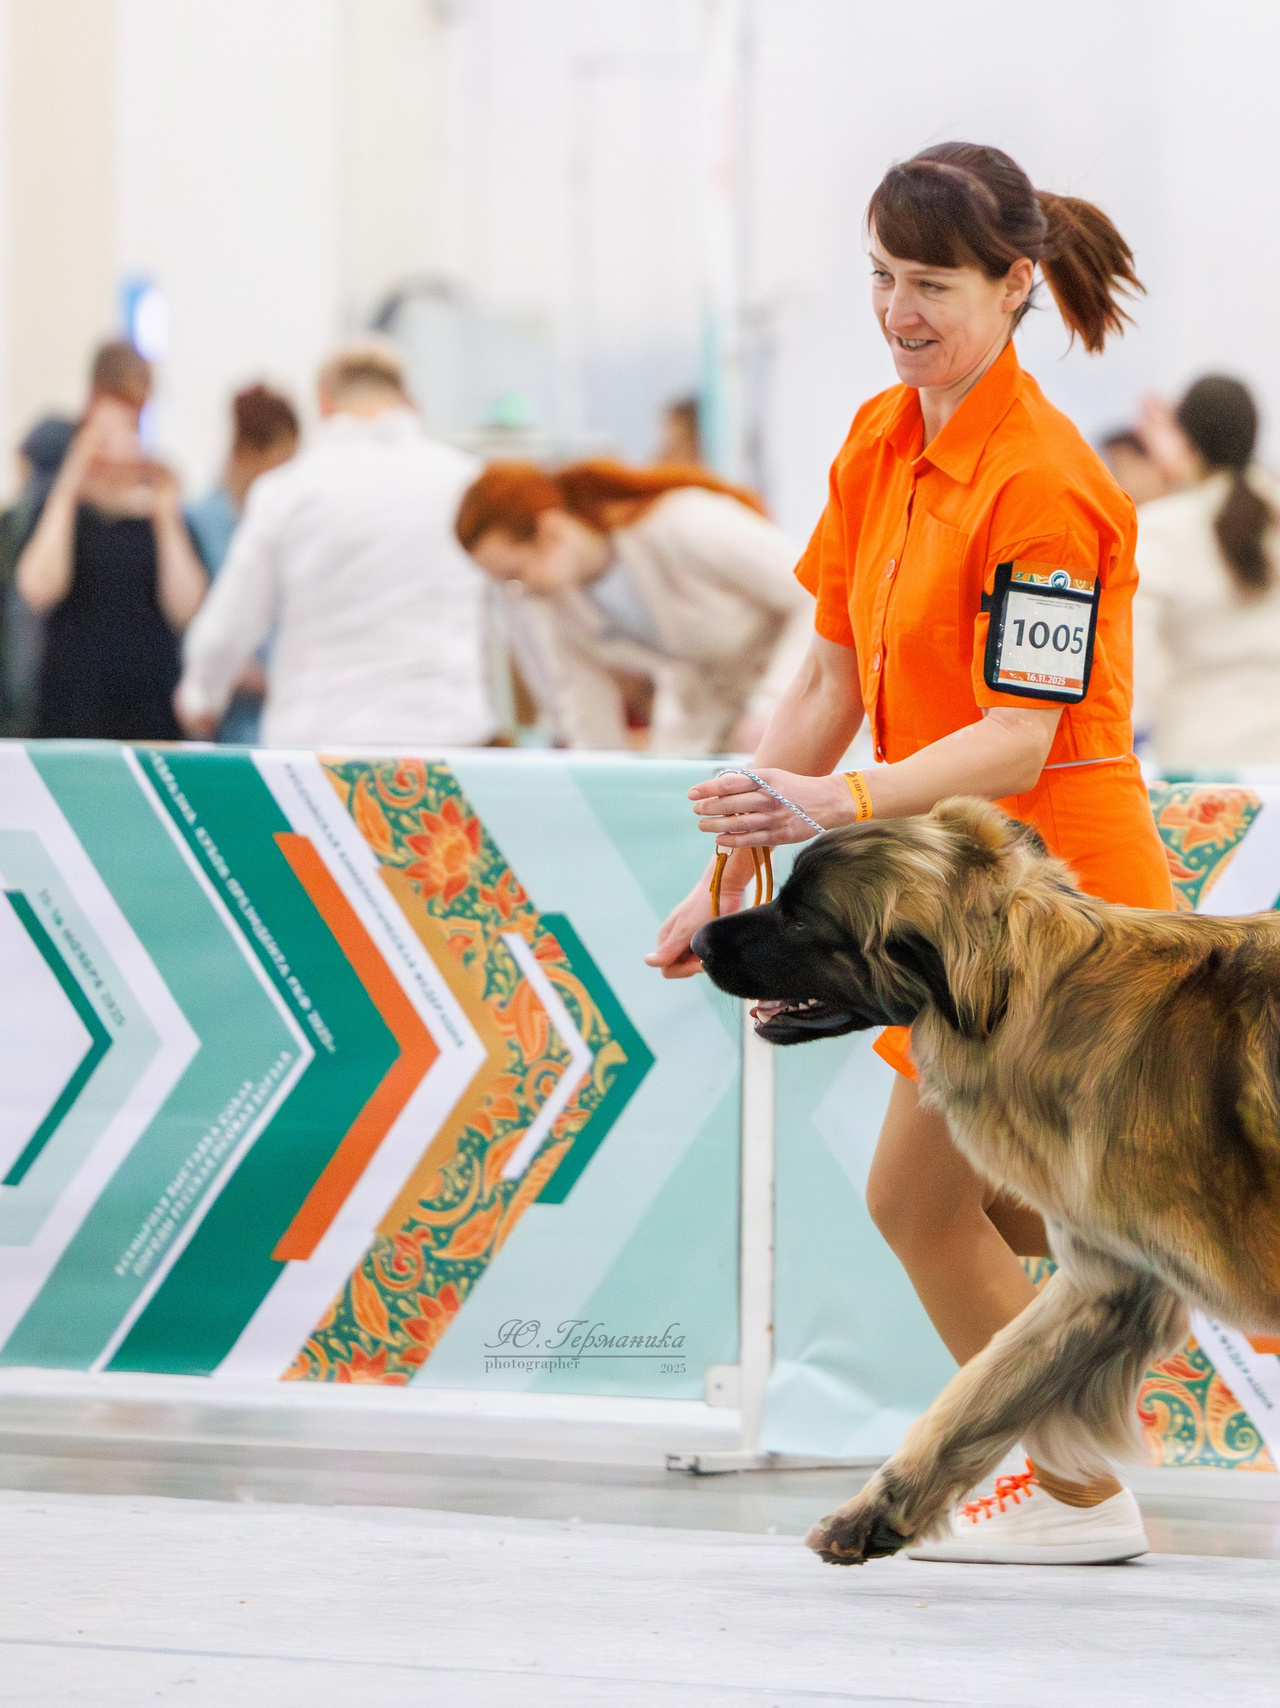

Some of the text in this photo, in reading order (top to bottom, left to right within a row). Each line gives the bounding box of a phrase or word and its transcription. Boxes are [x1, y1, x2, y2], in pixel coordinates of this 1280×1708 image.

[1013, 619, 1084, 655] 1005
[1026, 672, 1067, 686] 16.11.2025
[853, 779, 868, 818] ЕВРАЗИЯ
